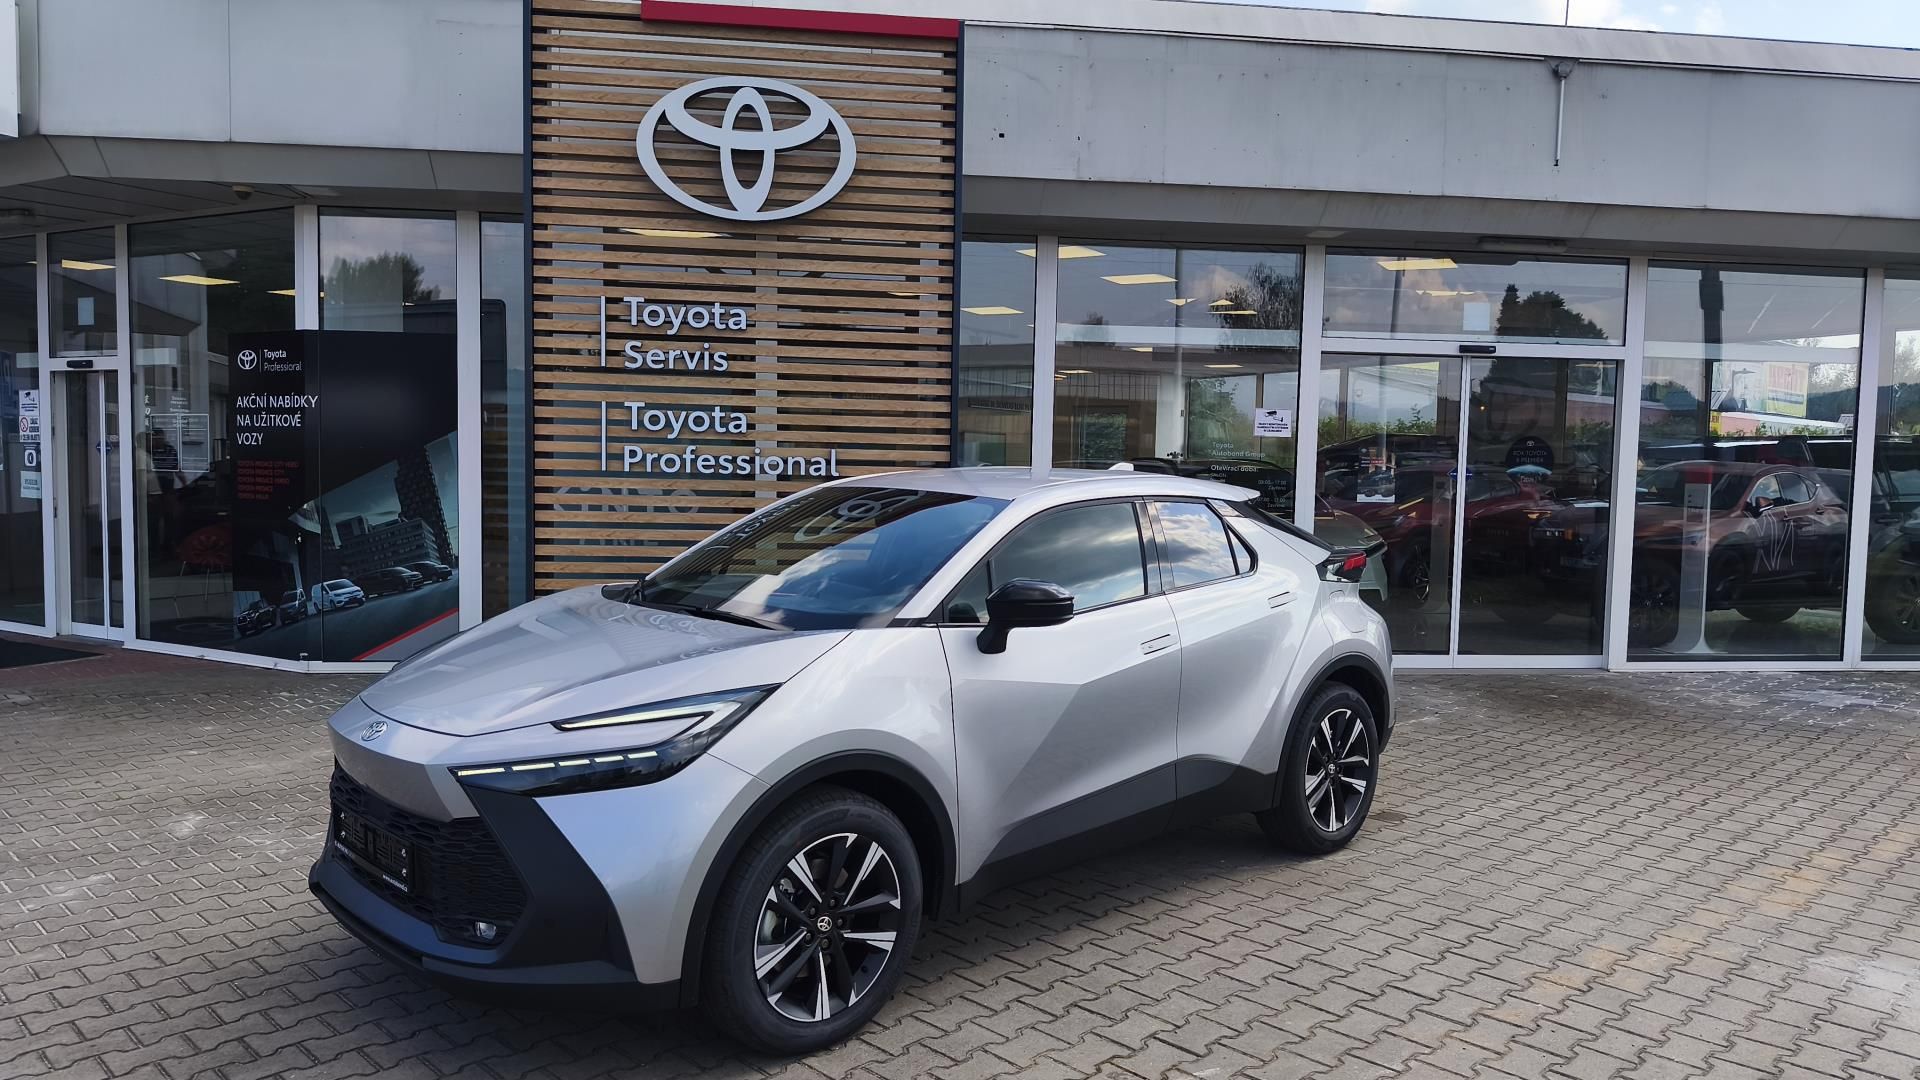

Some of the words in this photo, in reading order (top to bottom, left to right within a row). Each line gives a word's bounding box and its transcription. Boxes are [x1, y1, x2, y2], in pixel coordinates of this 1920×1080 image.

[623, 296, 748, 336] Toyota
[263, 349, 287, 361] Toyota
[624, 340, 729, 372] Servis
[236, 392, 267, 408] AKČNÍ
[269, 391, 319, 408] NABÍDKY
[237, 414, 252, 427] NA
[253, 410, 302, 427] UŽITKOVÉ
[623, 401, 748, 439] Toyota
[236, 432, 264, 445] VOZY
[623, 445, 840, 477] Professional
